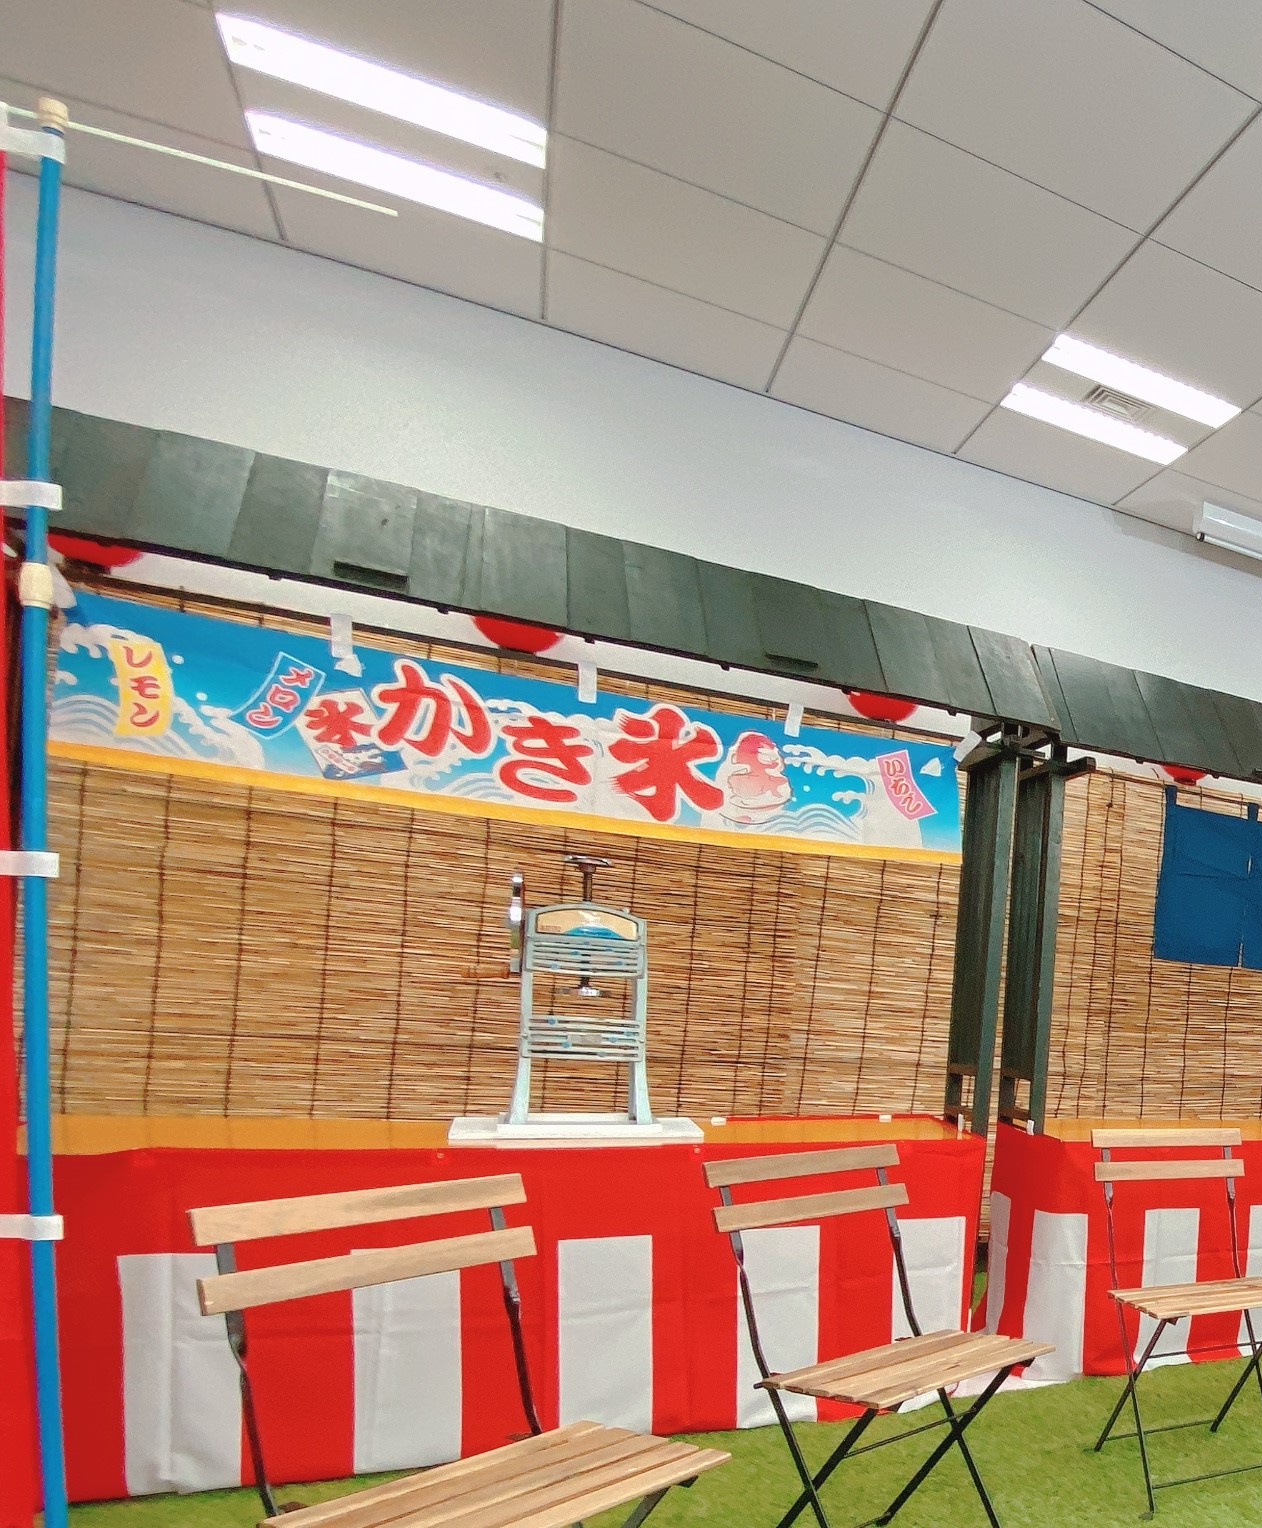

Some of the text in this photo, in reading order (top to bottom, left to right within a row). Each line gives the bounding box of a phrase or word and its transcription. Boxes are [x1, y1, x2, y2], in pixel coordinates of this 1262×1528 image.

[119, 643, 162, 729] レモン
[246, 667, 314, 728] メロン
[303, 698, 373, 749] 氷
[376, 660, 727, 823] かき氷
[884, 759, 922, 814] いちご
